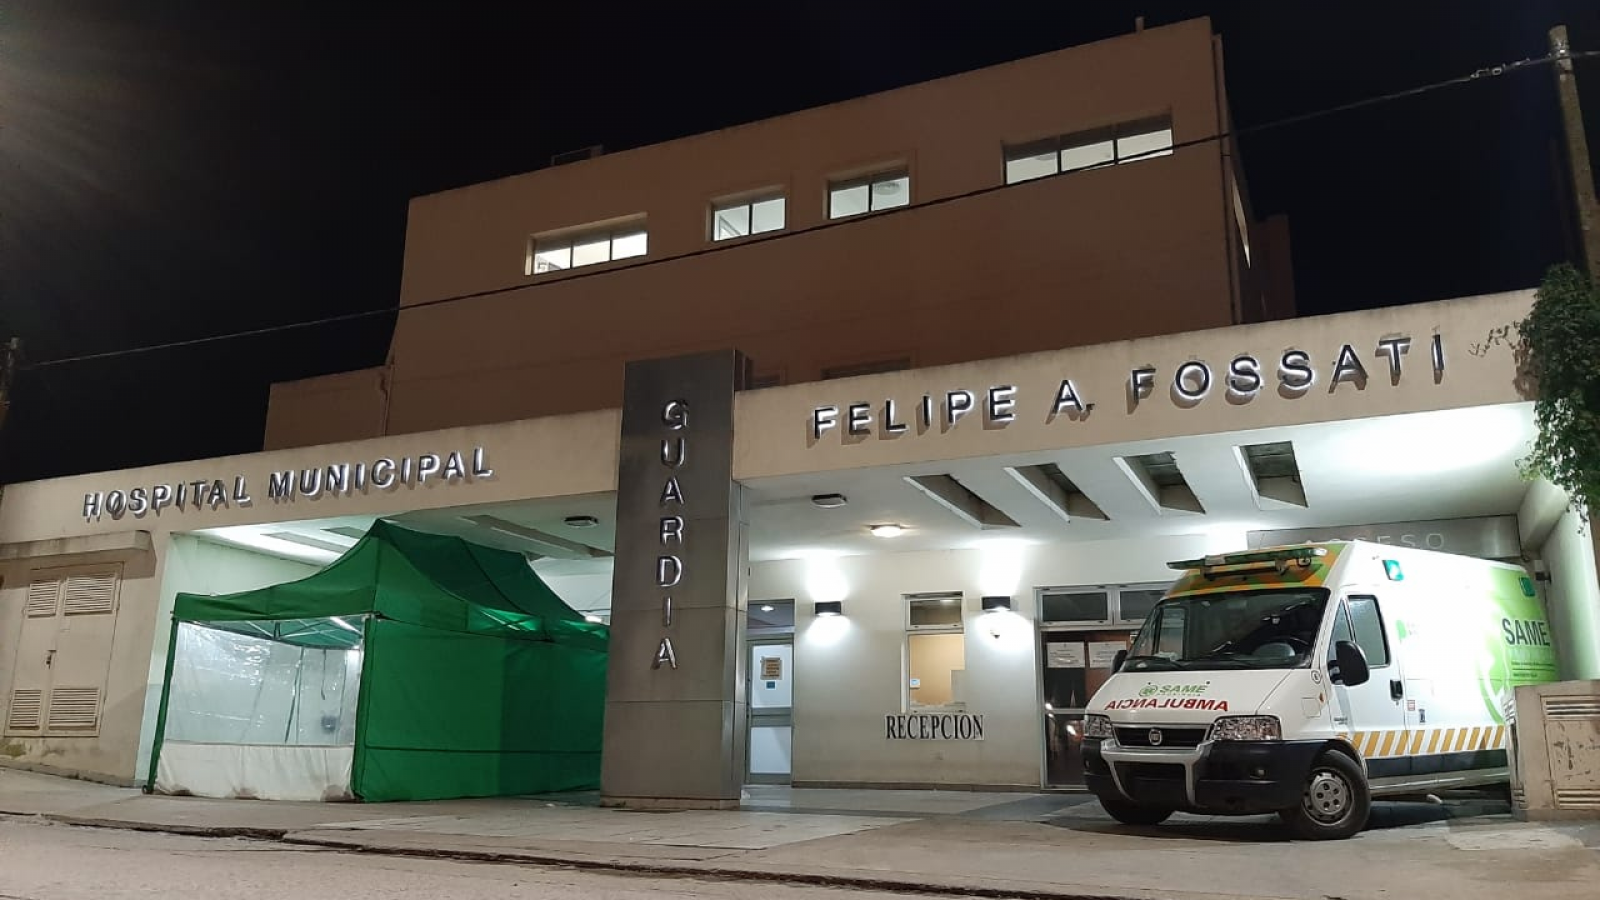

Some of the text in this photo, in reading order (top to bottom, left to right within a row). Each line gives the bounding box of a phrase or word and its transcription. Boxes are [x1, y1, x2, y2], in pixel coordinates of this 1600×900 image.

[812, 385, 1018, 440] FELIPE
[1130, 332, 1446, 405] FOSSATI
[81, 447, 494, 522] HOSPITAL MUNICIPAL
[654, 400, 690, 671] GUARDIA
[1306, 532, 1445, 549] ESO
[1501, 617, 1551, 647] SAME
[1159, 684, 1207, 694] SAME
[885, 714, 984, 740] RECEPCION
